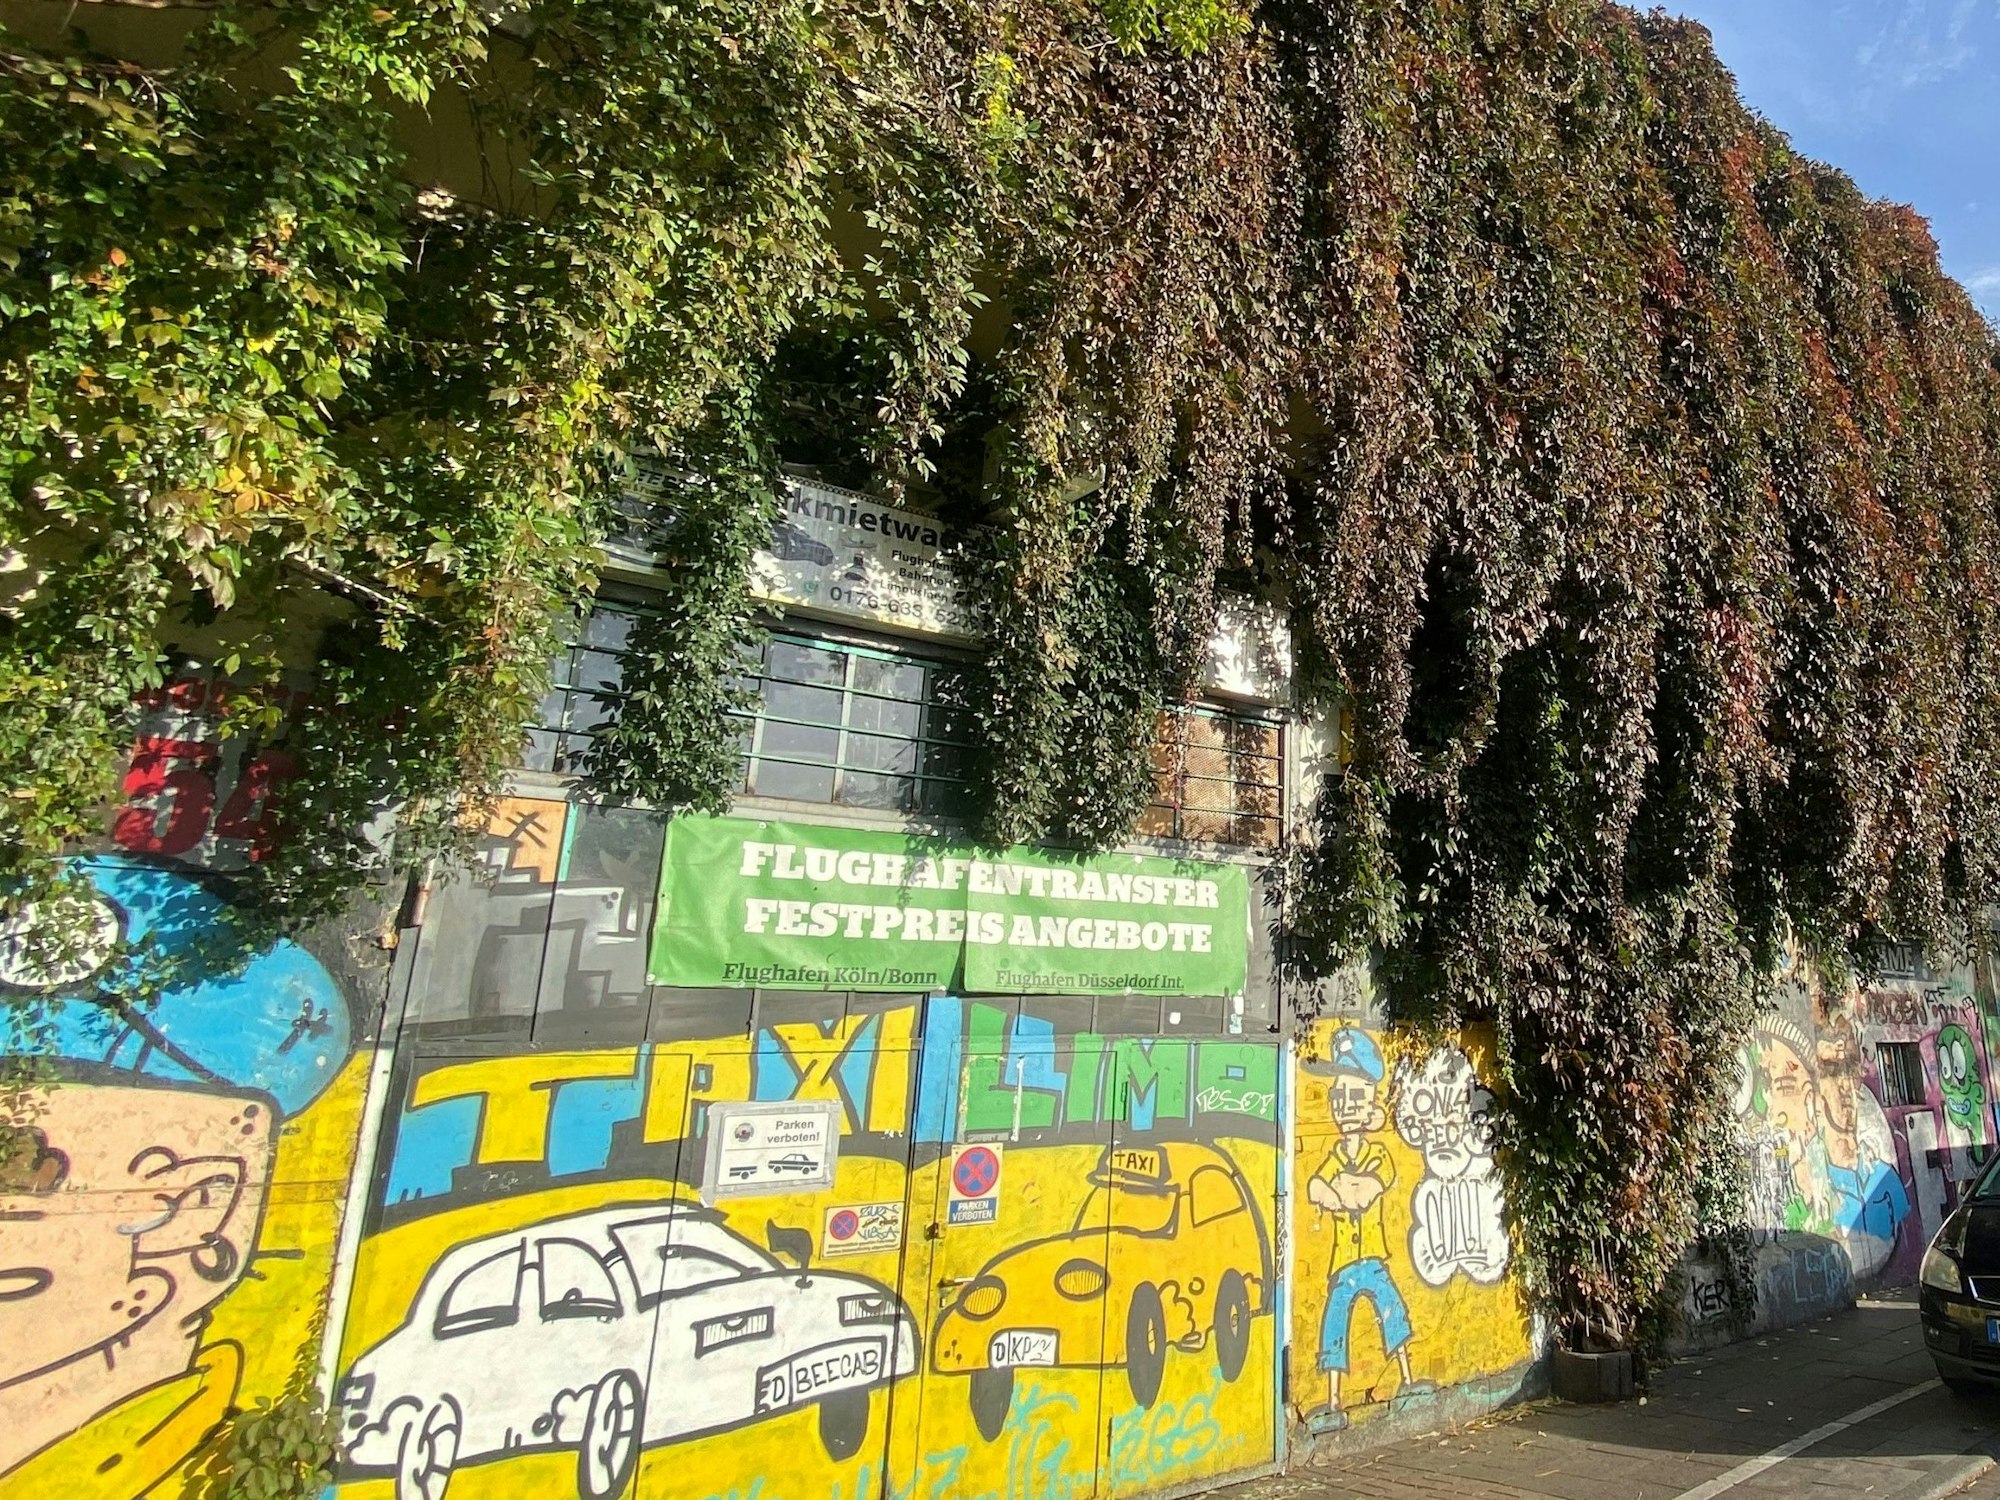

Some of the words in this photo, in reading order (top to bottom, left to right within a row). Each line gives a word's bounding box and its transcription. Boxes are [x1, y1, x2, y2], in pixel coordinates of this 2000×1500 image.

[739, 841, 1219, 909] FLUGHAFENTRANSFER
[722, 963, 829, 982] Flughafen
[834, 967, 938, 985] Köln/Bonn
[995, 970, 1074, 988] Flughafen
[1078, 973, 1162, 989] Düsseldorf
[1162, 975, 1185, 989] Int.
[775, 1120, 814, 1130] Parken
[767, 1131, 820, 1143] verboten!
[1114, 1152, 1154, 1174] TAXI
[957, 1200, 989, 1211] PARKEN
[952, 1210, 993, 1222] VERBOTEN
[795, 1349, 879, 1394] BEECAB
